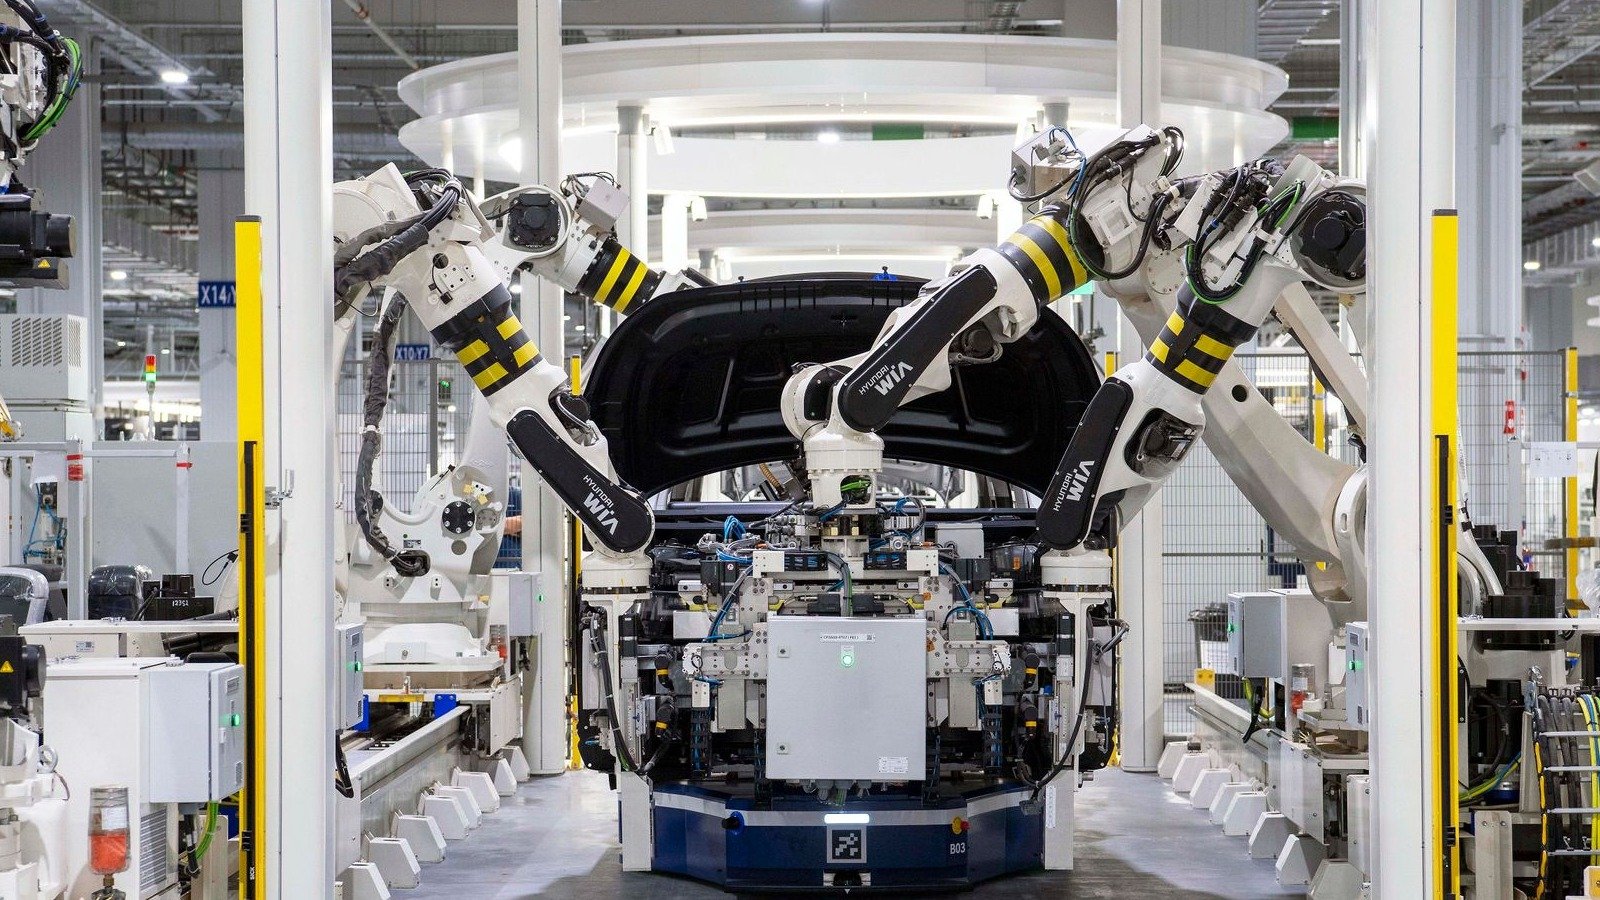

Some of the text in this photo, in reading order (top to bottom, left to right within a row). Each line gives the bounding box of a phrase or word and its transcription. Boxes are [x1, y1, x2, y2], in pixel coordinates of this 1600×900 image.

[858, 364, 890, 396] HYUNDAI
[582, 474, 614, 509] HYUNDAI
[1052, 472, 1074, 512] HYUNDAI
[949, 842, 966, 855] B03
